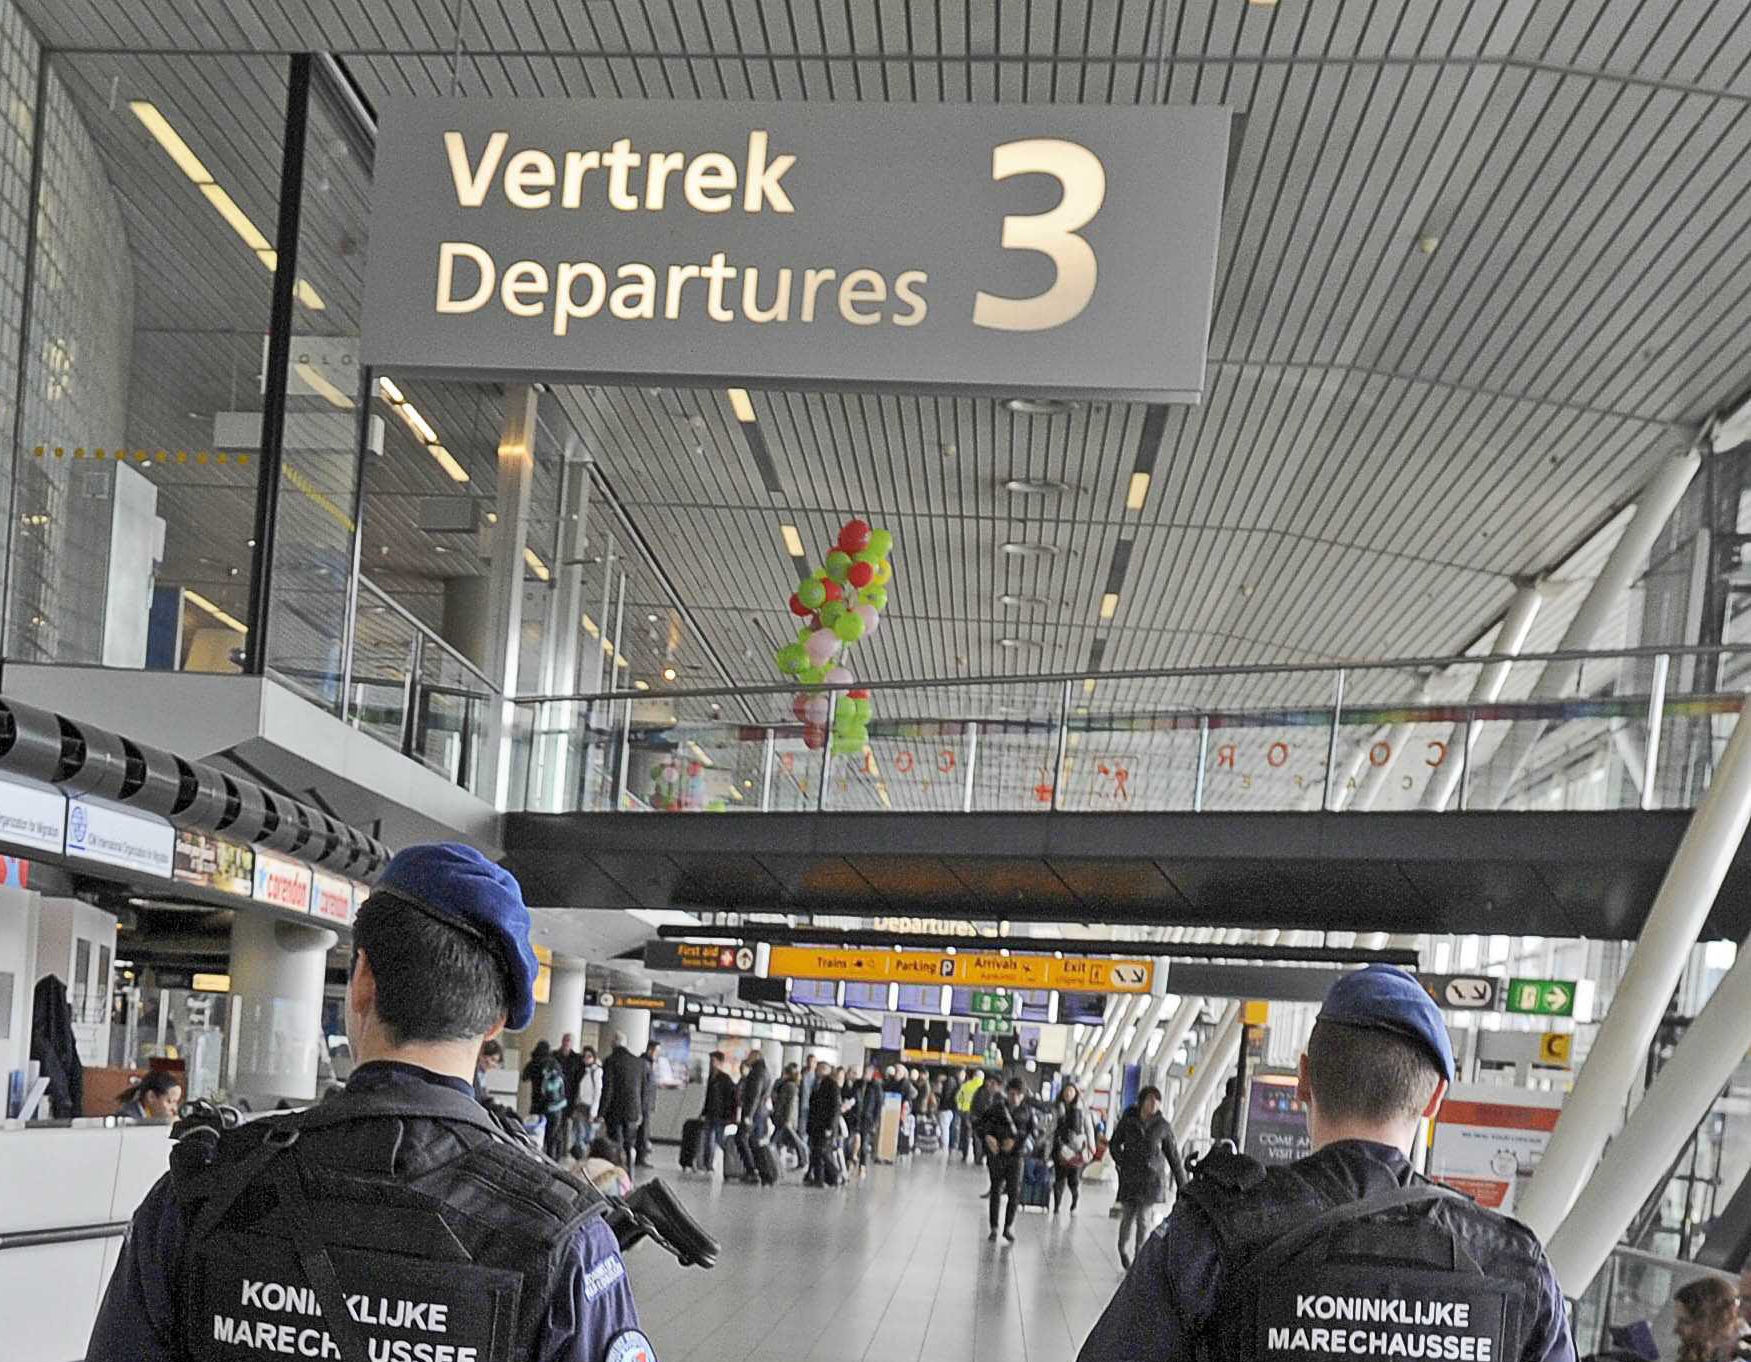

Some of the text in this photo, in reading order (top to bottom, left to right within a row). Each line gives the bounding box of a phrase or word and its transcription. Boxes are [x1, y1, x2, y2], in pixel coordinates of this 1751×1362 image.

[444, 130, 798, 213] Vertrek
[972, 138, 1107, 332] 3
[434, 241, 930, 336] Departures
[817, 957, 847, 970] Trains
[896, 959, 937, 976] Parking
[1063, 961, 1087, 974] Exit
[241, 1279, 448, 1333] KONIKLIJKE
[1296, 1295, 1470, 1328] KONINKLIJKE
[1268, 1327, 1492, 1362] MARECHAUSSEE
